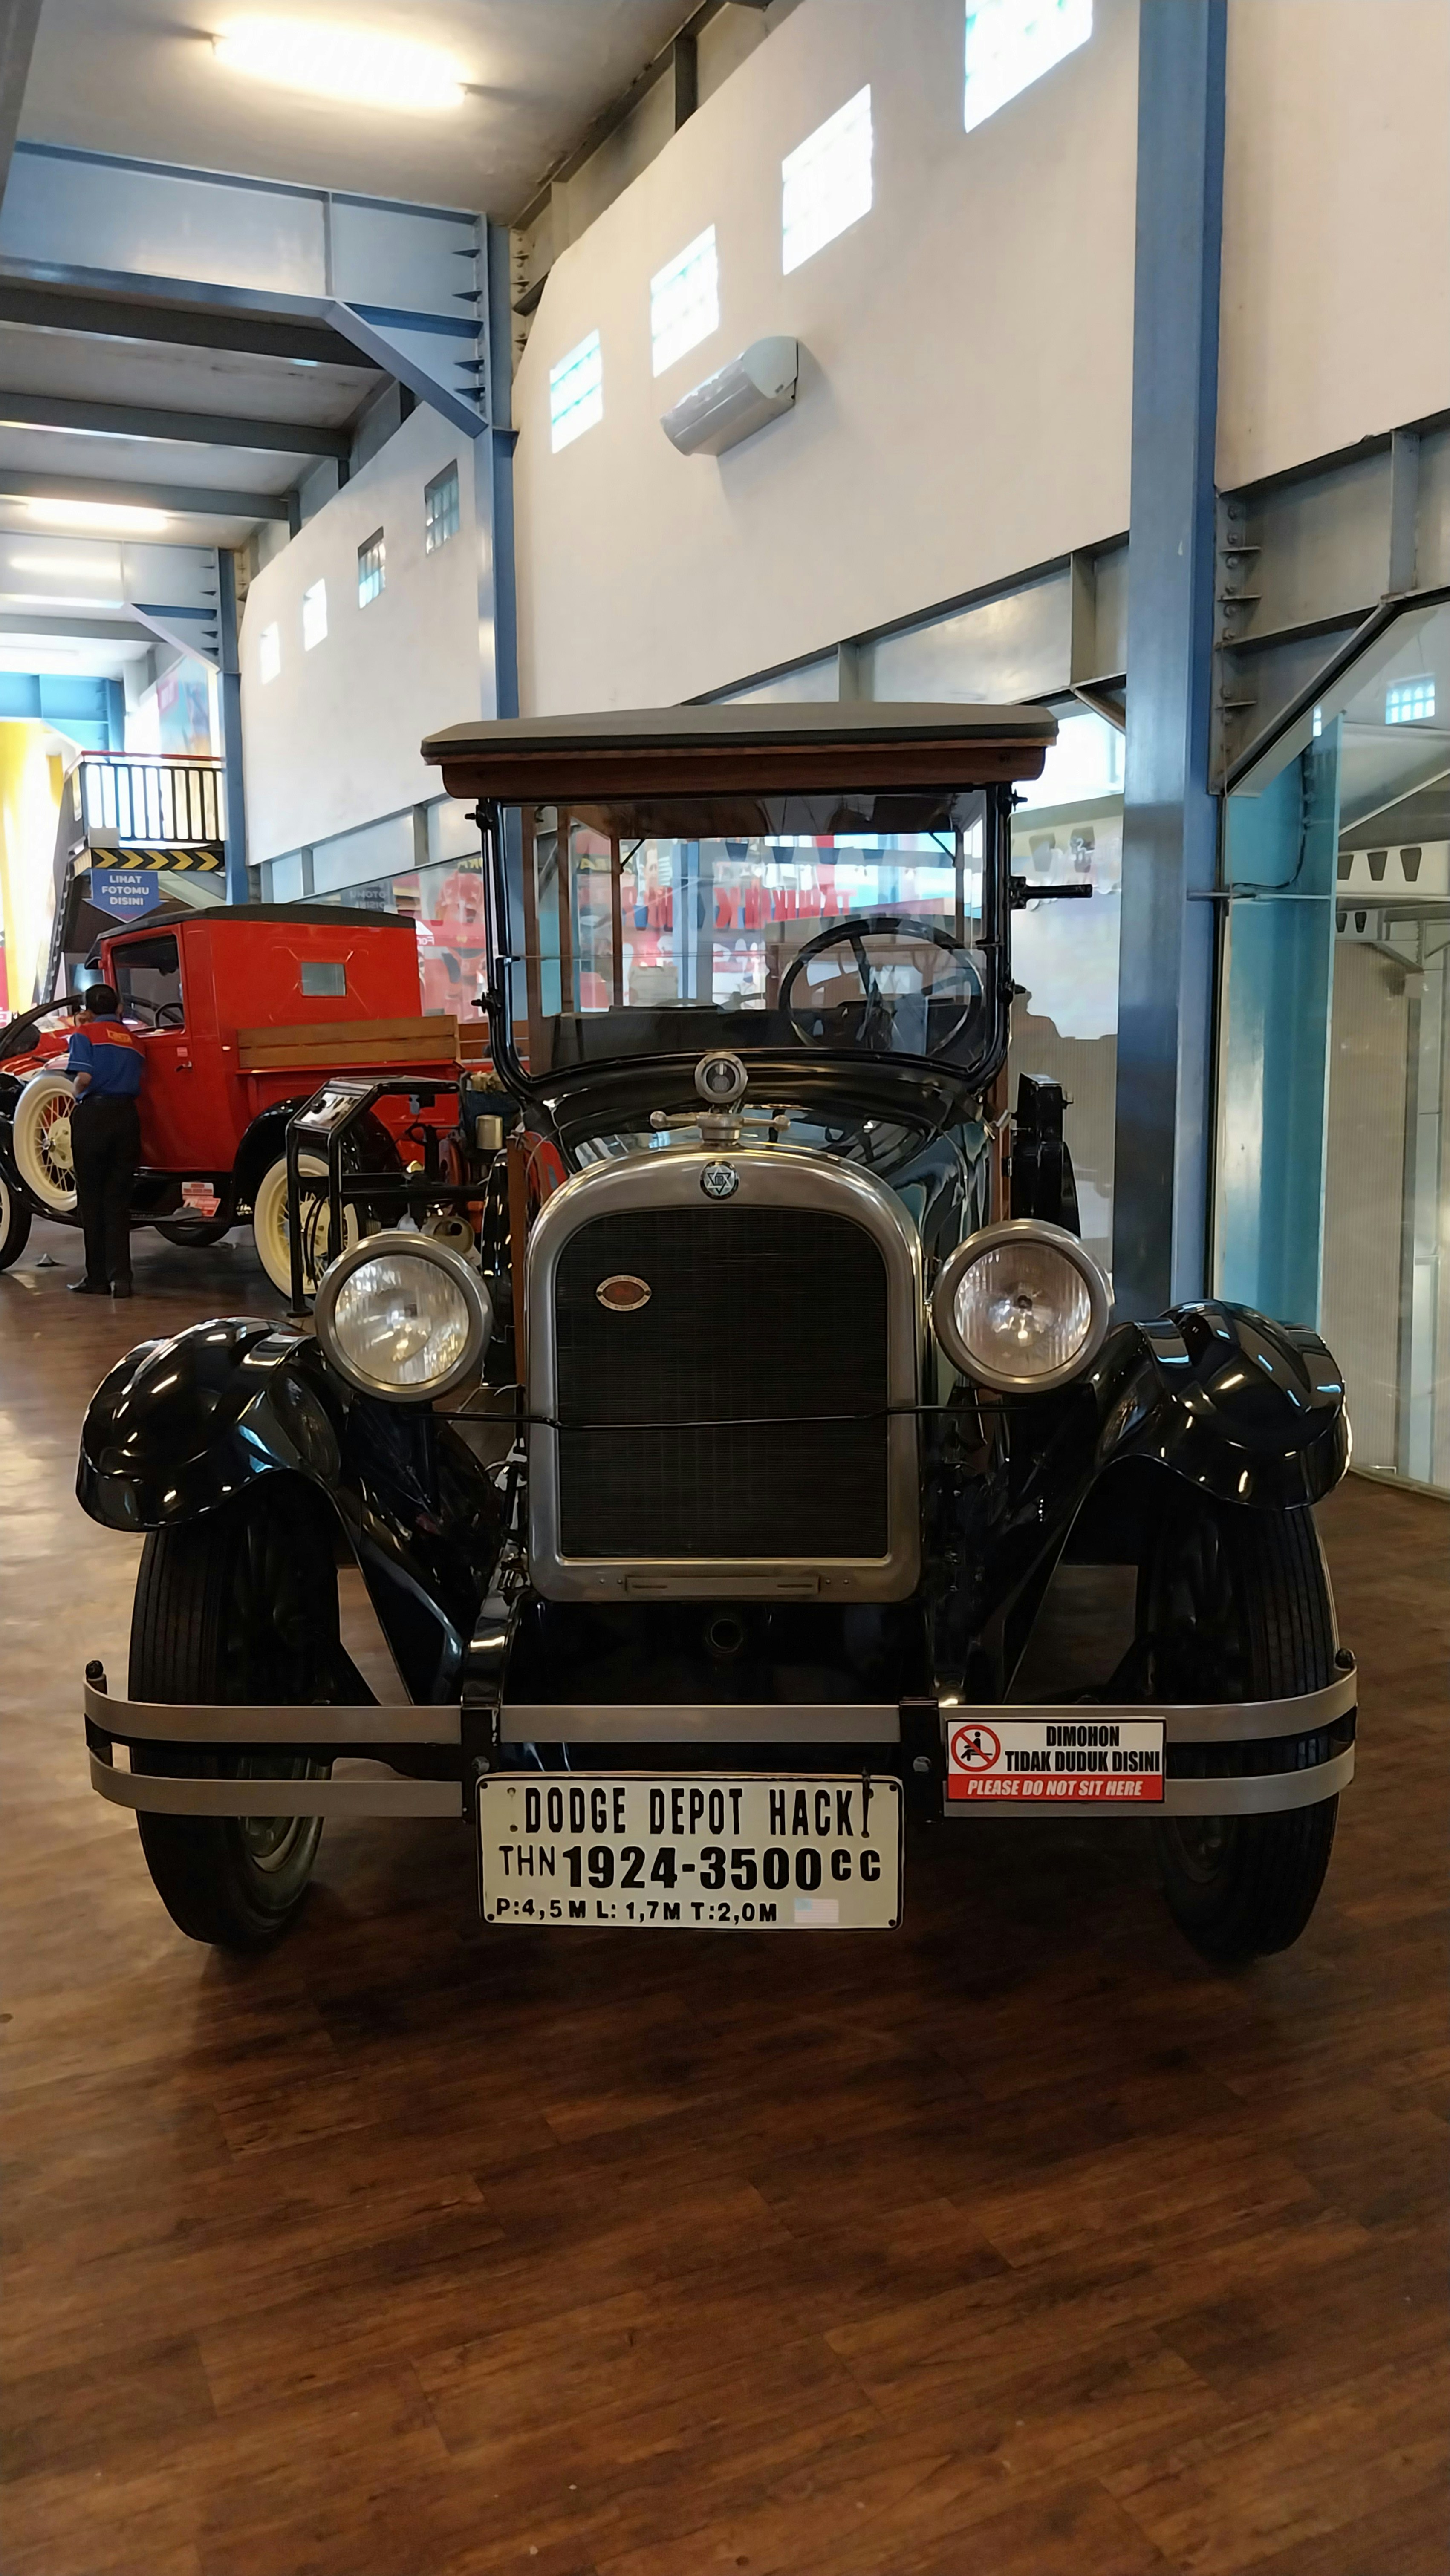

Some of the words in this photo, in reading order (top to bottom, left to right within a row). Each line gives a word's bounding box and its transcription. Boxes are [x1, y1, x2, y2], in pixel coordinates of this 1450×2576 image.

[110, 875, 142, 883] LIHAT
[101, 886, 149, 895] FOTOMU
[110, 897, 144, 906] DISINI
[1046, 1725, 1120, 1747] DIMOHON
[1005, 1751, 1051, 1772] TIDAK
[1055, 1751, 1109, 1772] DUDUK
[1112, 1751, 1160, 1772] DISINI
[967, 1780, 1020, 1795] PLEASE
[1022, 1780, 1044, 1796] DO
[1046, 1780, 1077, 1796] NOT
[1078, 1780, 1104, 1796] SIT
[1105, 1780, 1144, 1796] HERE
[525, 1787, 626, 1834] DODGE
[649, 1788, 743, 1835] DEPOT
